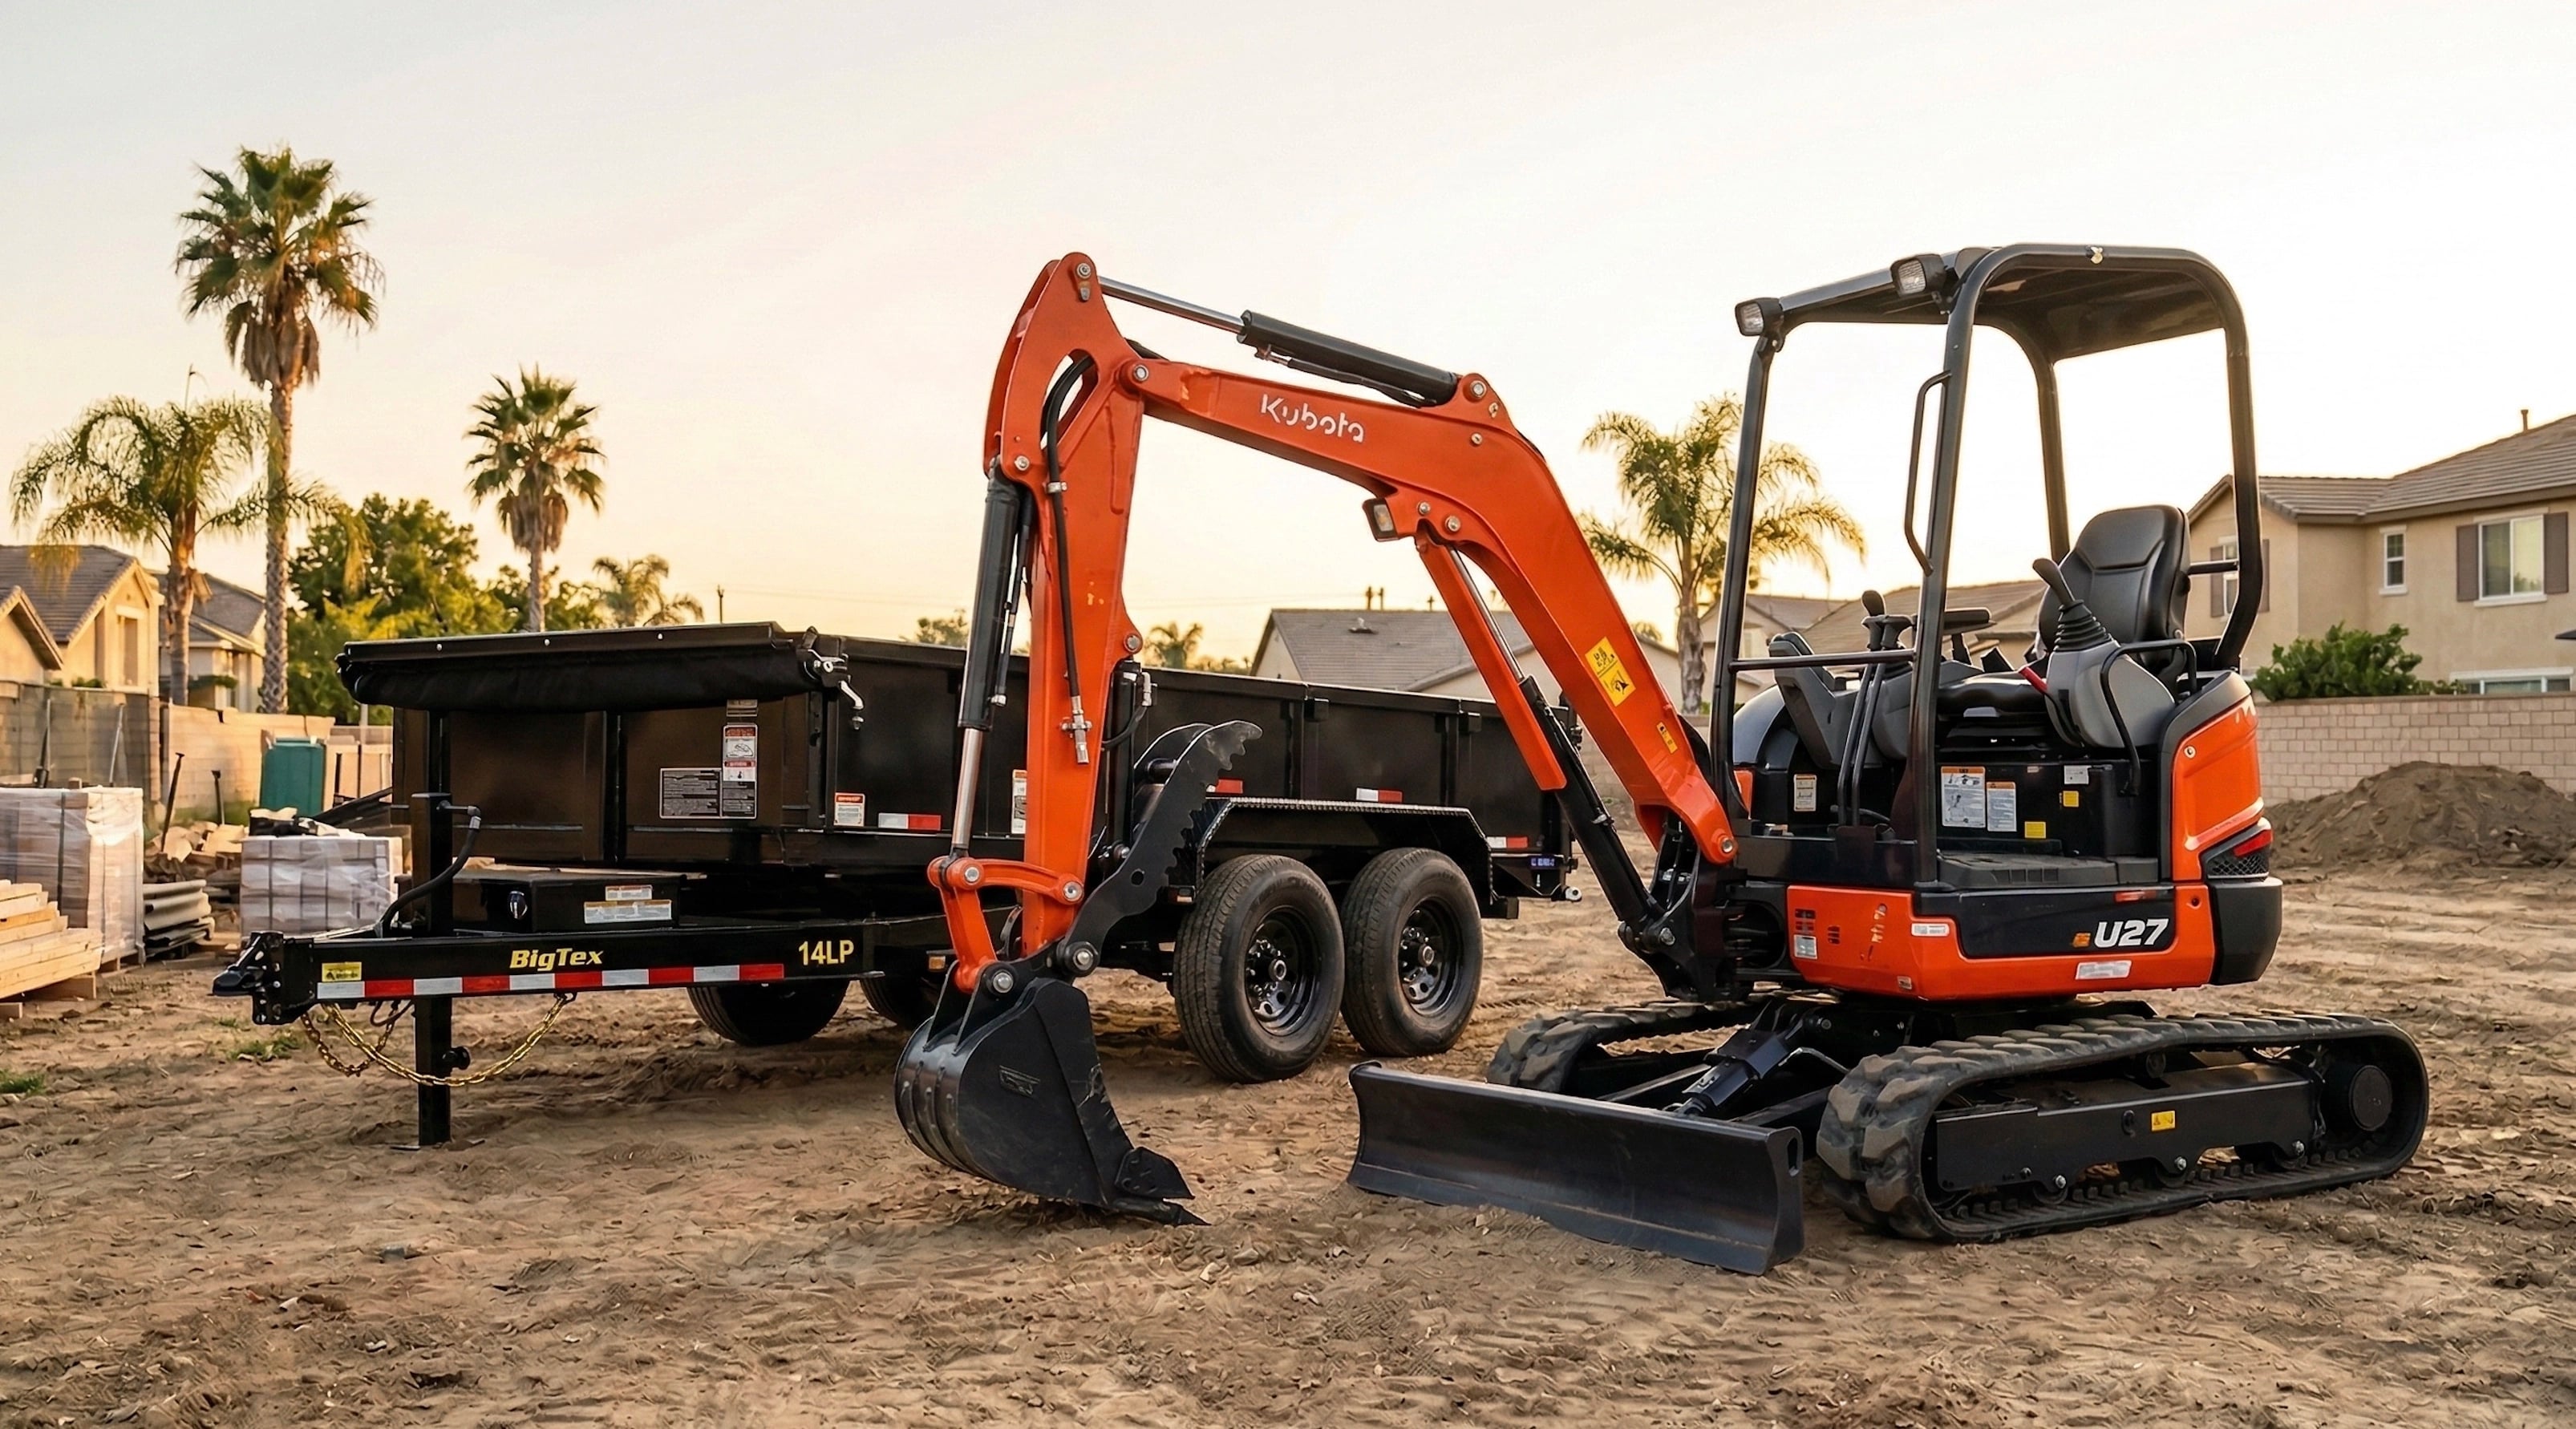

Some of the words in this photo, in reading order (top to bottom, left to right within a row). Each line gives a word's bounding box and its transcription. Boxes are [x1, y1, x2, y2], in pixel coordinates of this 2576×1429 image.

[1261, 394, 1364, 443] Kubota
[2094, 918, 2169, 948] U27
[509, 948, 604, 972] BigTex
[798, 939, 855, 965] 14LP
